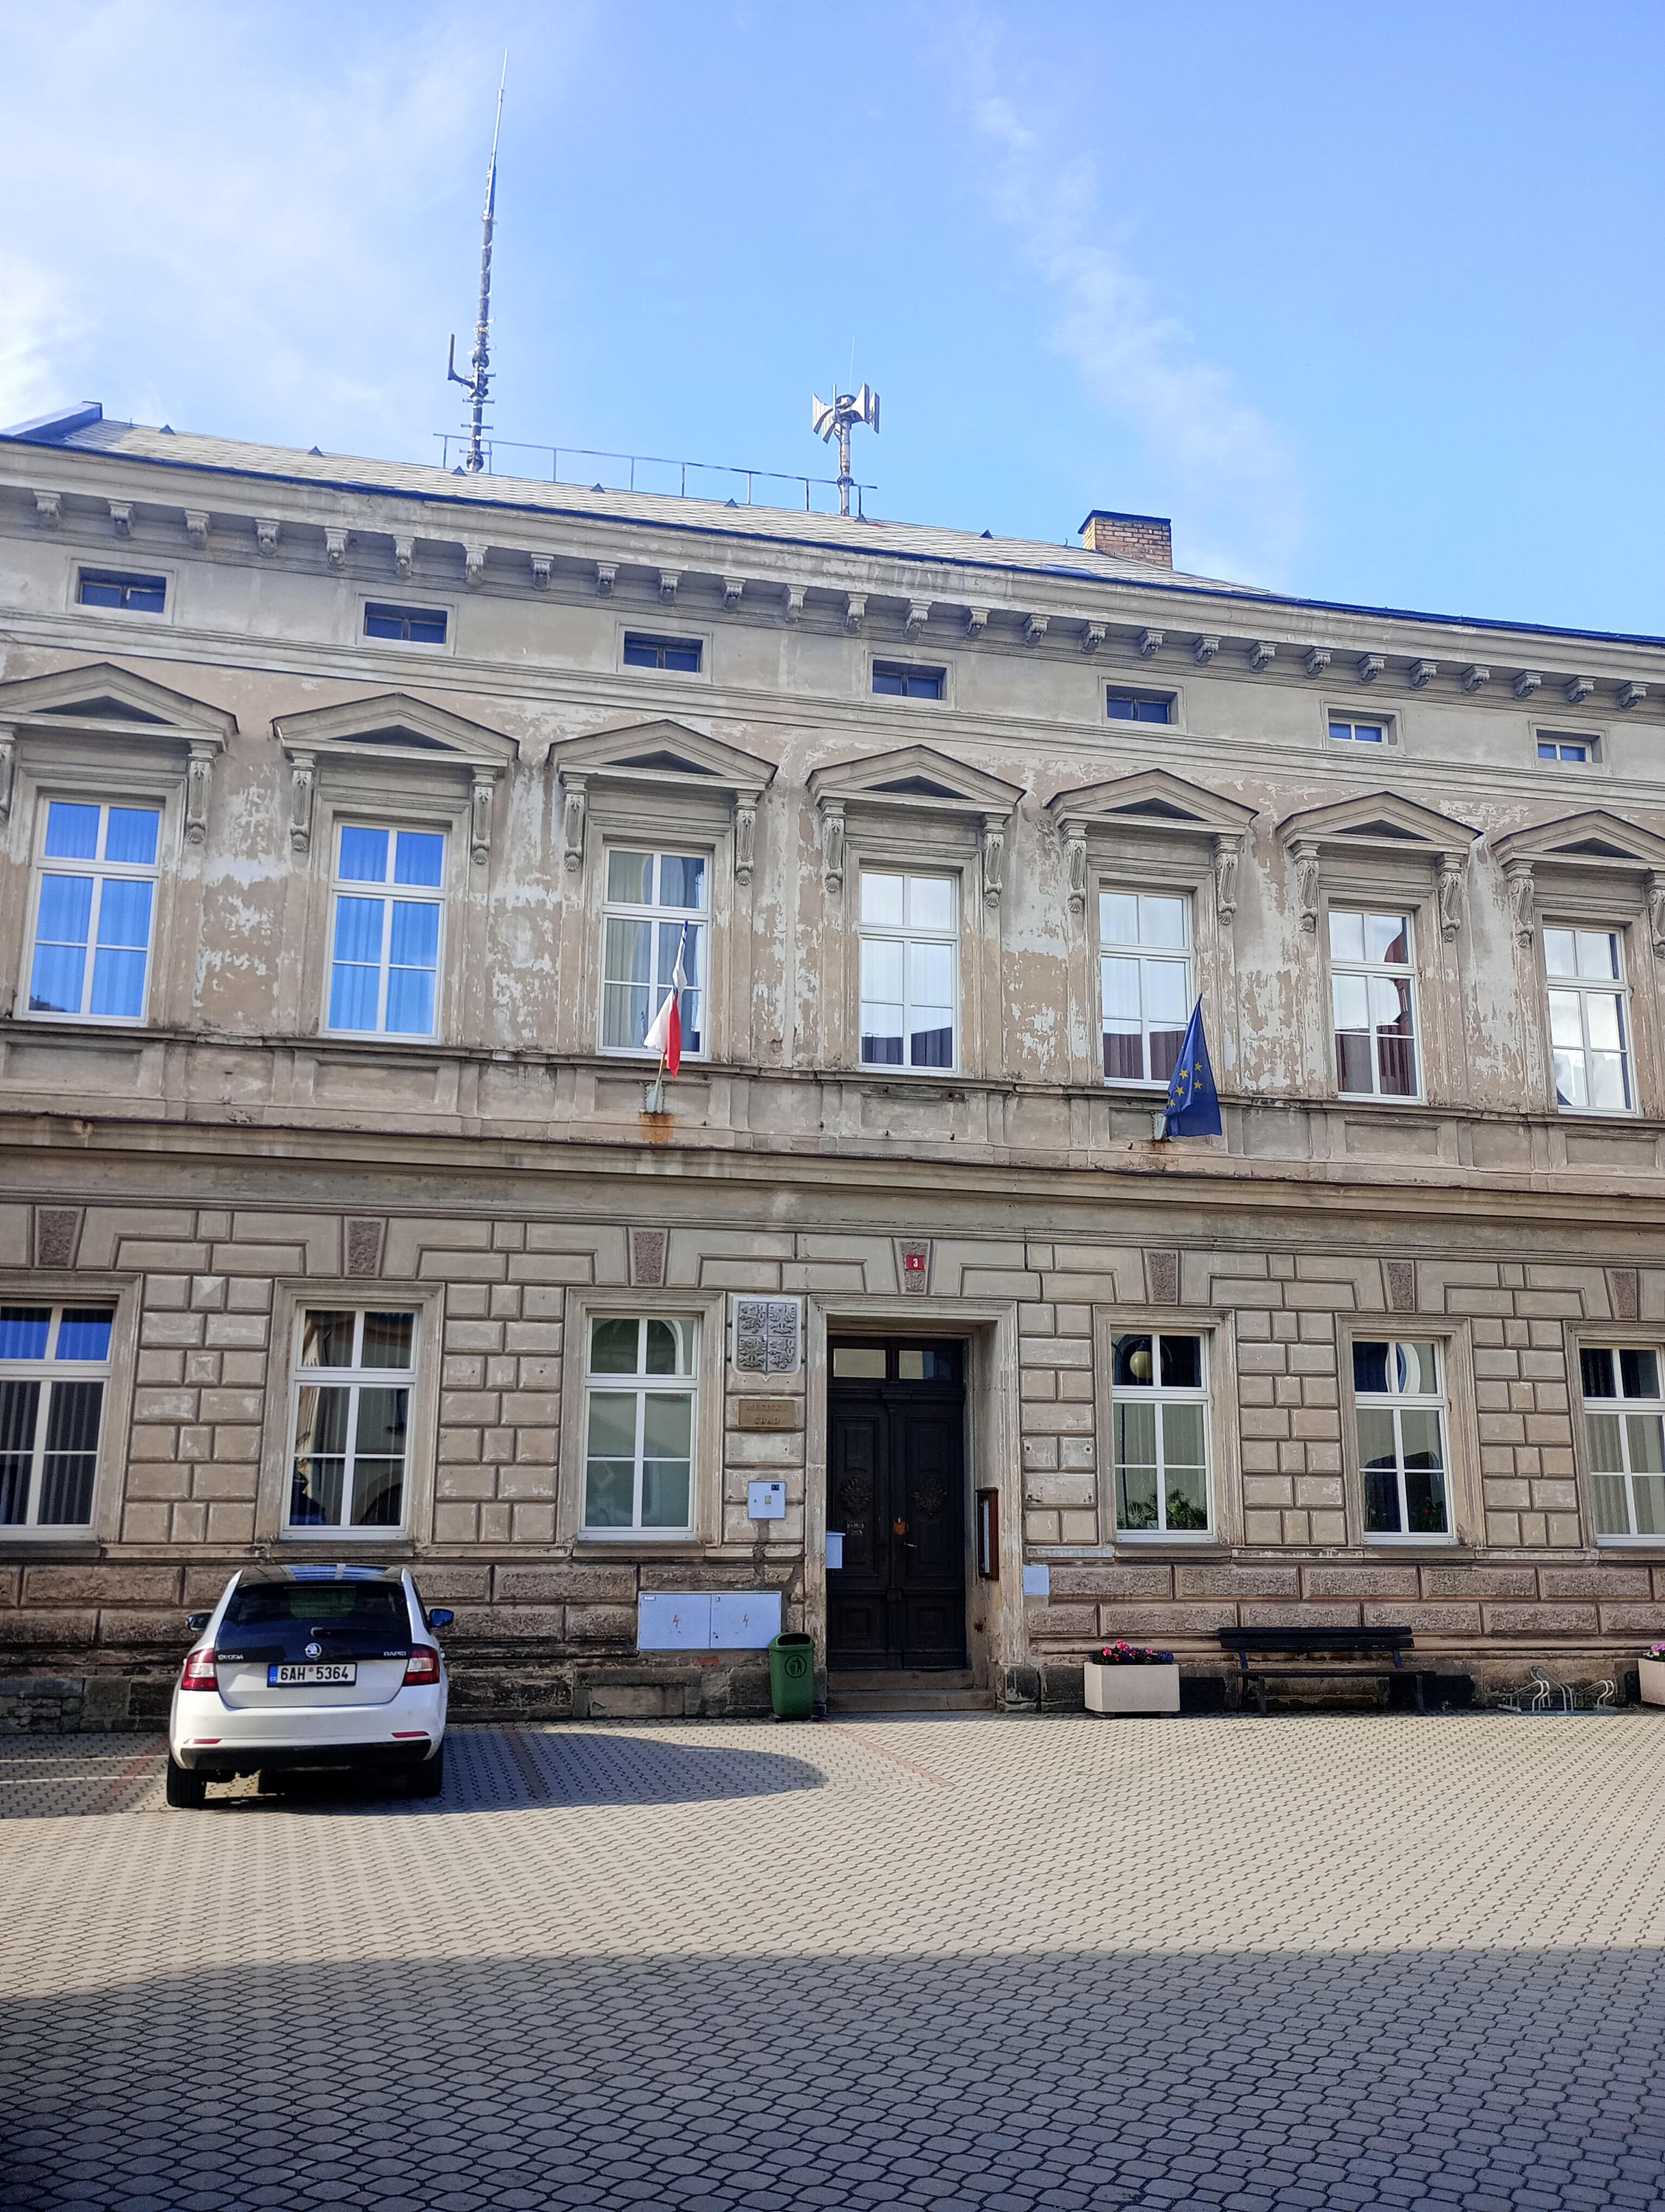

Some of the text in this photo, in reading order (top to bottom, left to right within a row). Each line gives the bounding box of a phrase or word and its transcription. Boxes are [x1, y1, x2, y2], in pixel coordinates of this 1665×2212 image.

[913, 1258, 918, 1267] 3
[280, 1666, 349, 1680] 6AH 5364
